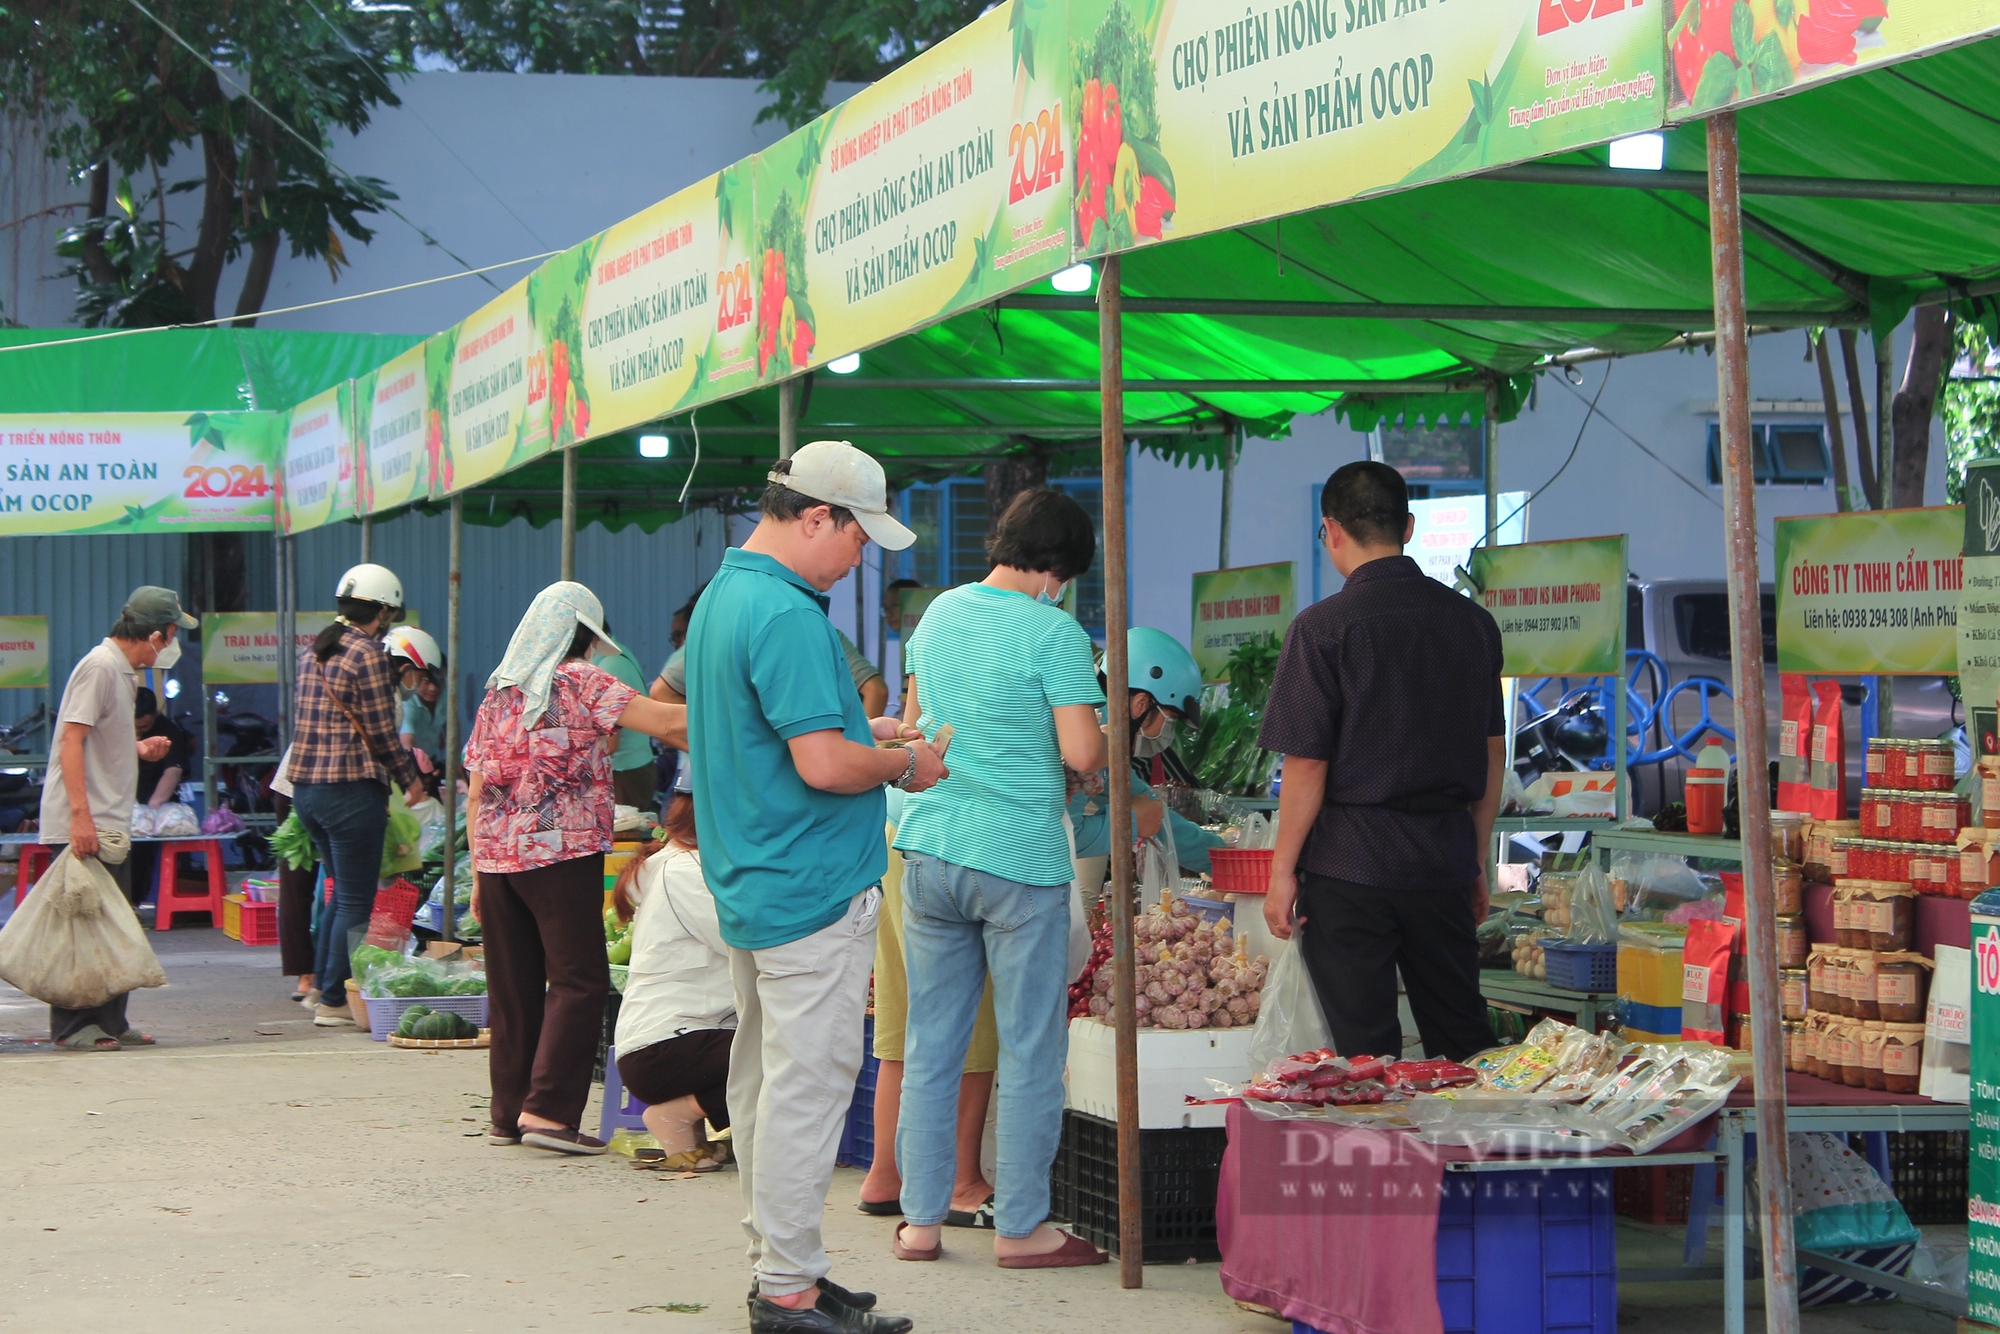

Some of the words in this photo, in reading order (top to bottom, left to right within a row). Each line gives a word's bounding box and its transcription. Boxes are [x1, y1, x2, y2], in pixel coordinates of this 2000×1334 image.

[1172, 30, 1209, 93] CHỢ
[1215, 7, 1269, 77] PHIÊN
[1546, 67, 1561, 86] Đơn
[1588, 55, 1608, 74] hiện:
[1228, 96, 1254, 158] VÀ
[1259, 81, 1298, 150] SẢN
[1304, 55, 1363, 138] PHẨM
[1370, 53, 1434, 119] OCOP
[1509, 108, 1530, 128] Trung
[1531, 103, 1544, 120] tâm
[1546, 98, 1556, 118] Tư
[1557, 90, 1571, 110] vấn
[1572, 92, 1581, 109] và
[1582, 82, 1593, 107] Hỗ
[1594, 87, 1606, 110] trợ
[1607, 80, 1626, 103] nông
[1627, 72, 1655, 100] nghiệp
[1008, 103, 1064, 205] 2024
[815, 210, 836, 255] CHỢ
[840, 192, 869, 244] PHIÊN
[873, 177, 906, 227] NÔNG
[910, 154, 933, 208] SẢN
[937, 150, 954, 196] AN
[958, 126, 993, 184] TOÀN
[846, 258, 860, 304] VÀ
[863, 246, 884, 297] SẢN
[888, 224, 919, 286] PHẨM
[923, 220, 957, 270] OCOP
[588, 315, 603, 351] CHỢ
[605, 304, 626, 343] PHIÊN
[627, 296, 650, 334] NÔNG
[652, 282, 668, 324] SẢN
[670, 283, 682, 316] AN
[684, 268, 707, 310] TOÀN
[716, 261, 753, 333] 2024
[527, 348, 547, 406] 2024
[610, 356, 620, 392] VÀ
[621, 349, 637, 388] SẢN
[638, 336, 660, 383] PHẨM
[661, 338, 684, 374] OCOP
[9, 428, 44, 446] TRIỂN
[50, 431, 84, 446] NÔNG
[89, 431, 121, 445] THÔN
[6, 458, 50, 481] SẢN
[58, 464, 88, 481] AN
[97, 459, 158, 480] TOÀN
[183, 464, 270, 498] 2024
[31, 494, 93, 512] OCOP
[1793, 559, 1829, 596] CÔNG
[1833, 564, 1849, 594] TY
[1854, 562, 1891, 593] TNHH
[1896, 548, 1929, 592] CẨM
[1485, 589, 1498, 608] CTY
[1499, 588, 1517, 607] TNHH
[1519, 587, 1538, 606] TMDV
[1540, 586, 1550, 605] NS
[1552, 585, 1568, 604] NAM
[1502, 619, 1514, 633] Liên
[1524, 618, 1538, 632] 0944
[1539, 618, 1549, 631] 337
[1551, 617, 1561, 631] 902
[1804, 609, 1823, 629] Liên
[1825, 608, 1840, 634] hệ:
[1842, 609, 1867, 628] 0938
[1869, 608, 1887, 628] 294
[1890, 608, 1908, 628] 308
[1910, 605, 1934, 630] (Anh
[1972, 629, 1986, 640] Khô
[223, 635, 250, 649] TRẠI
[234, 654, 250, 662] Liên
[1974, 656, 1987, 667] Khô
[1976, 1080, 1994, 1100] TÔM
[1976, 1110, 1999, 1131] ĐÁNH
